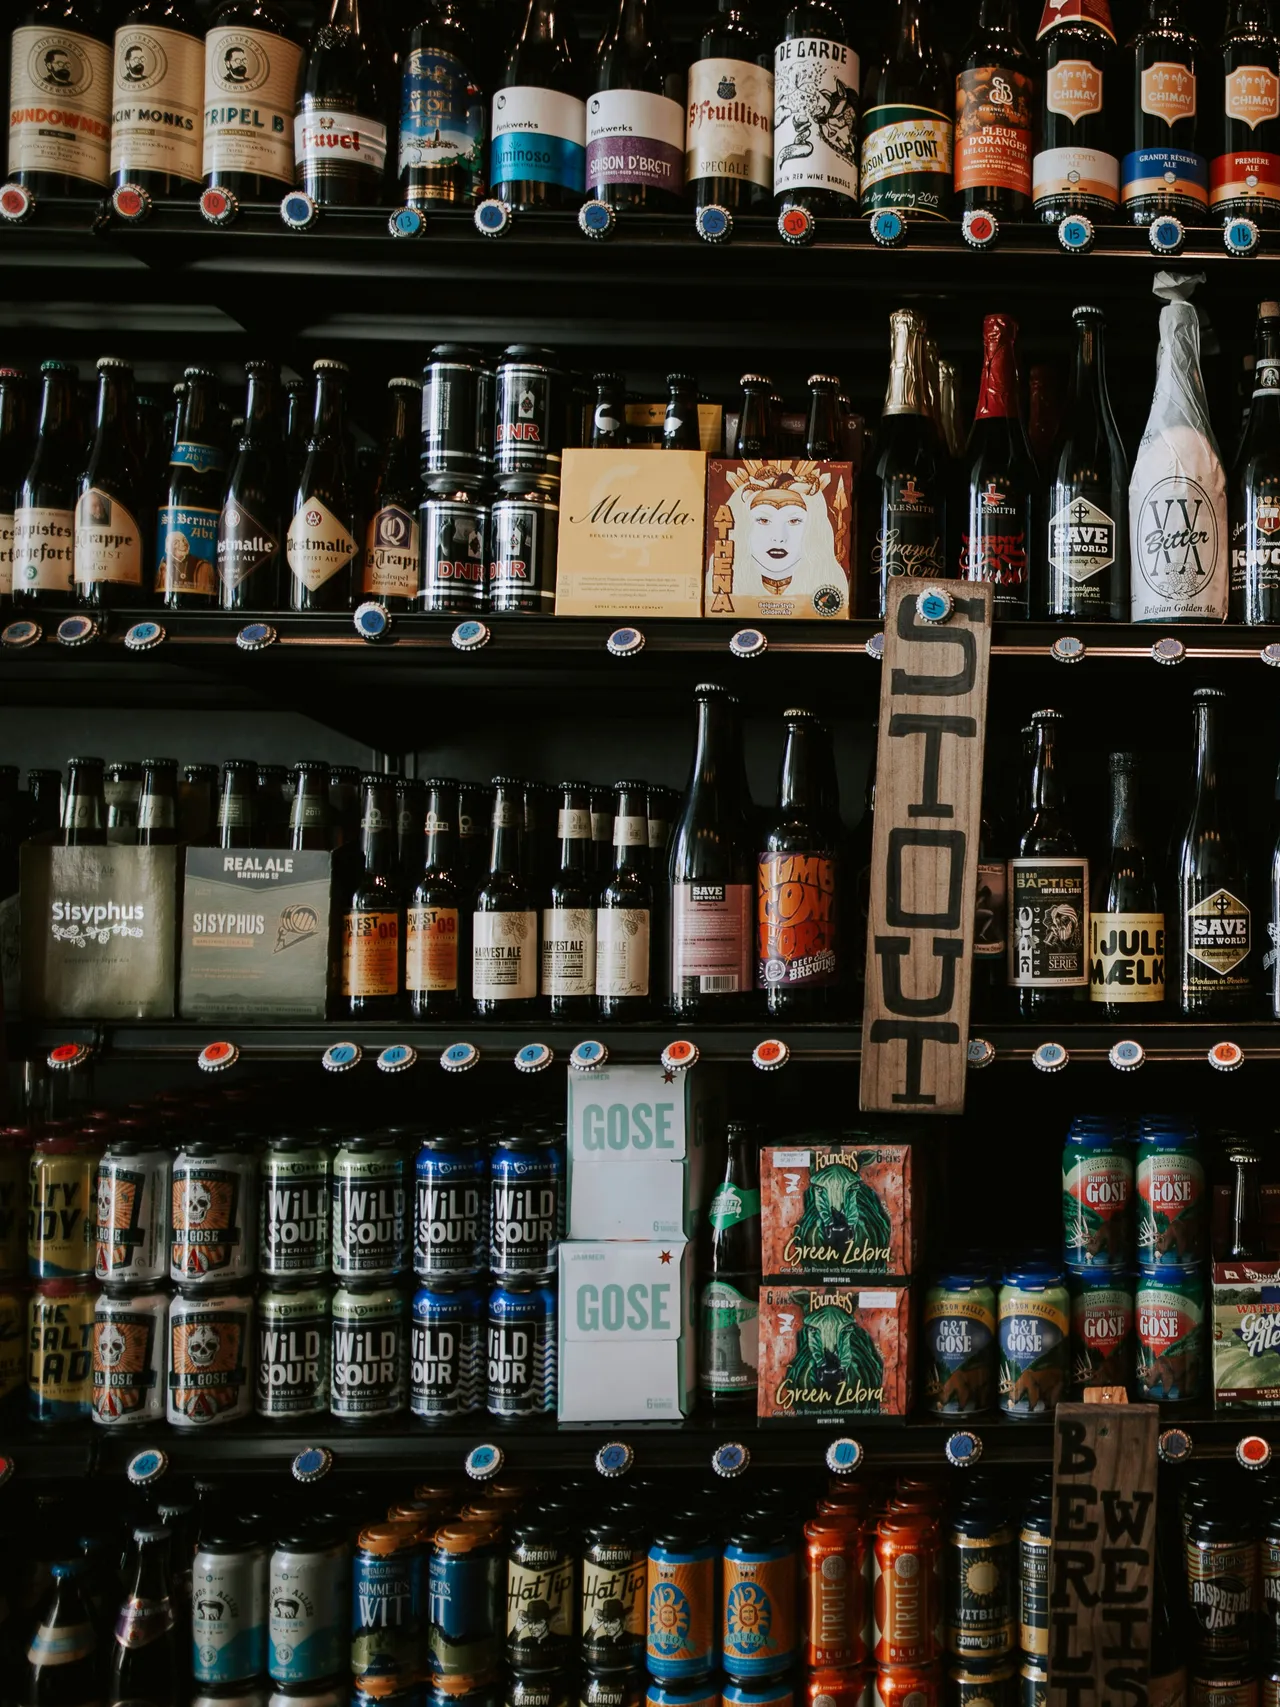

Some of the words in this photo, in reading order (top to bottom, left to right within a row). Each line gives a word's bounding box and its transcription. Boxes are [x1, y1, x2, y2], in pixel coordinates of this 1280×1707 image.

[780, 43, 794, 62] DE
[797, 41, 848, 65] GARDE
[1053, 90, 1097, 101] CHIMAY
[1147, 92, 1192, 105] CHIMAY
[1232, 95, 1274, 106] CHIMAY
[204, 108, 263, 128] TRIPEL
[273, 115, 284, 132] B
[982, 126, 1017, 139] FLEUR
[969, 134, 1028, 153] D'ORANGER
[1139, 154, 1168, 162] GRANDE
[1234, 157, 1270, 166] PREMIÈRE
[700, 159, 750, 176] SPECIALE
[1245, 164, 1259, 172] ALE
[807, 174, 824, 182] WINE
[828, 175, 851, 188] BARRELS
[497, 424, 540, 442] DNR
[569, 495, 695, 527] Matilda
[1054, 528, 1108, 544] SAVE
[1145, 528, 1209, 556] Bitter
[1073, 544, 1108, 553] WORLD
[712, 504, 735, 613] ATHENA
[438, 561, 486, 581] DNR
[1144, 604, 1171, 614] Belgian
[1173, 604, 1201, 613] Golden
[1203, 604, 1216, 613] Ale
[224, 857, 261, 872] REAL
[265, 858, 293, 873] ALE
[693, 886, 723, 896] SAVE
[1016, 877, 1083, 889] BAPTIST
[52, 901, 144, 924] Sisyphus
[193, 913, 265, 935] SISYPHUS
[1194, 919, 1246, 936] SAVE
[1194, 937, 1212, 945] THE
[1217, 937, 1246, 945] WORLD
[474, 946, 504, 958] HARVEST
[508, 946, 521, 957] ALE
[1049, 960, 1078, 970] SERIES
[582, 1103, 675, 1150] GOSE
[269, 1222, 326, 1244] SOUR
[420, 1222, 477, 1243] SOUR
[496, 1222, 552, 1243] SOUR
[784, 1235, 839, 1264] Green
[843, 1238, 891, 1265] Zebra
[33, 1305, 69, 1322] THE
[576, 1284, 671, 1331] GOSE
[940, 1321, 968, 1335] G&T
[1010, 1320, 1038, 1335] G&T
[936, 1337, 971, 1352] GOSE
[1007, 1335, 1042, 1352] GOSE
[106, 1373, 132, 1385] GOSE
[261, 1362, 318, 1385] SOUR
[336, 1362, 394, 1385] SOUR
[775, 1379, 831, 1408] Green
[836, 1380, 884, 1405] Zebra
[358, 1581, 410, 1595] SUMMER'S
[507, 1575, 541, 1612] Hat
[545, 1565, 571, 1598] Tip
[583, 1576, 616, 1611] Hat
[620, 1567, 644, 1599] Tip
[359, 1595, 410, 1628] WIT
[820, 1580, 845, 1643] CIRCLE
[894, 1575, 919, 1641] CIRCLE
[1205, 1608, 1235, 1629] JAM
